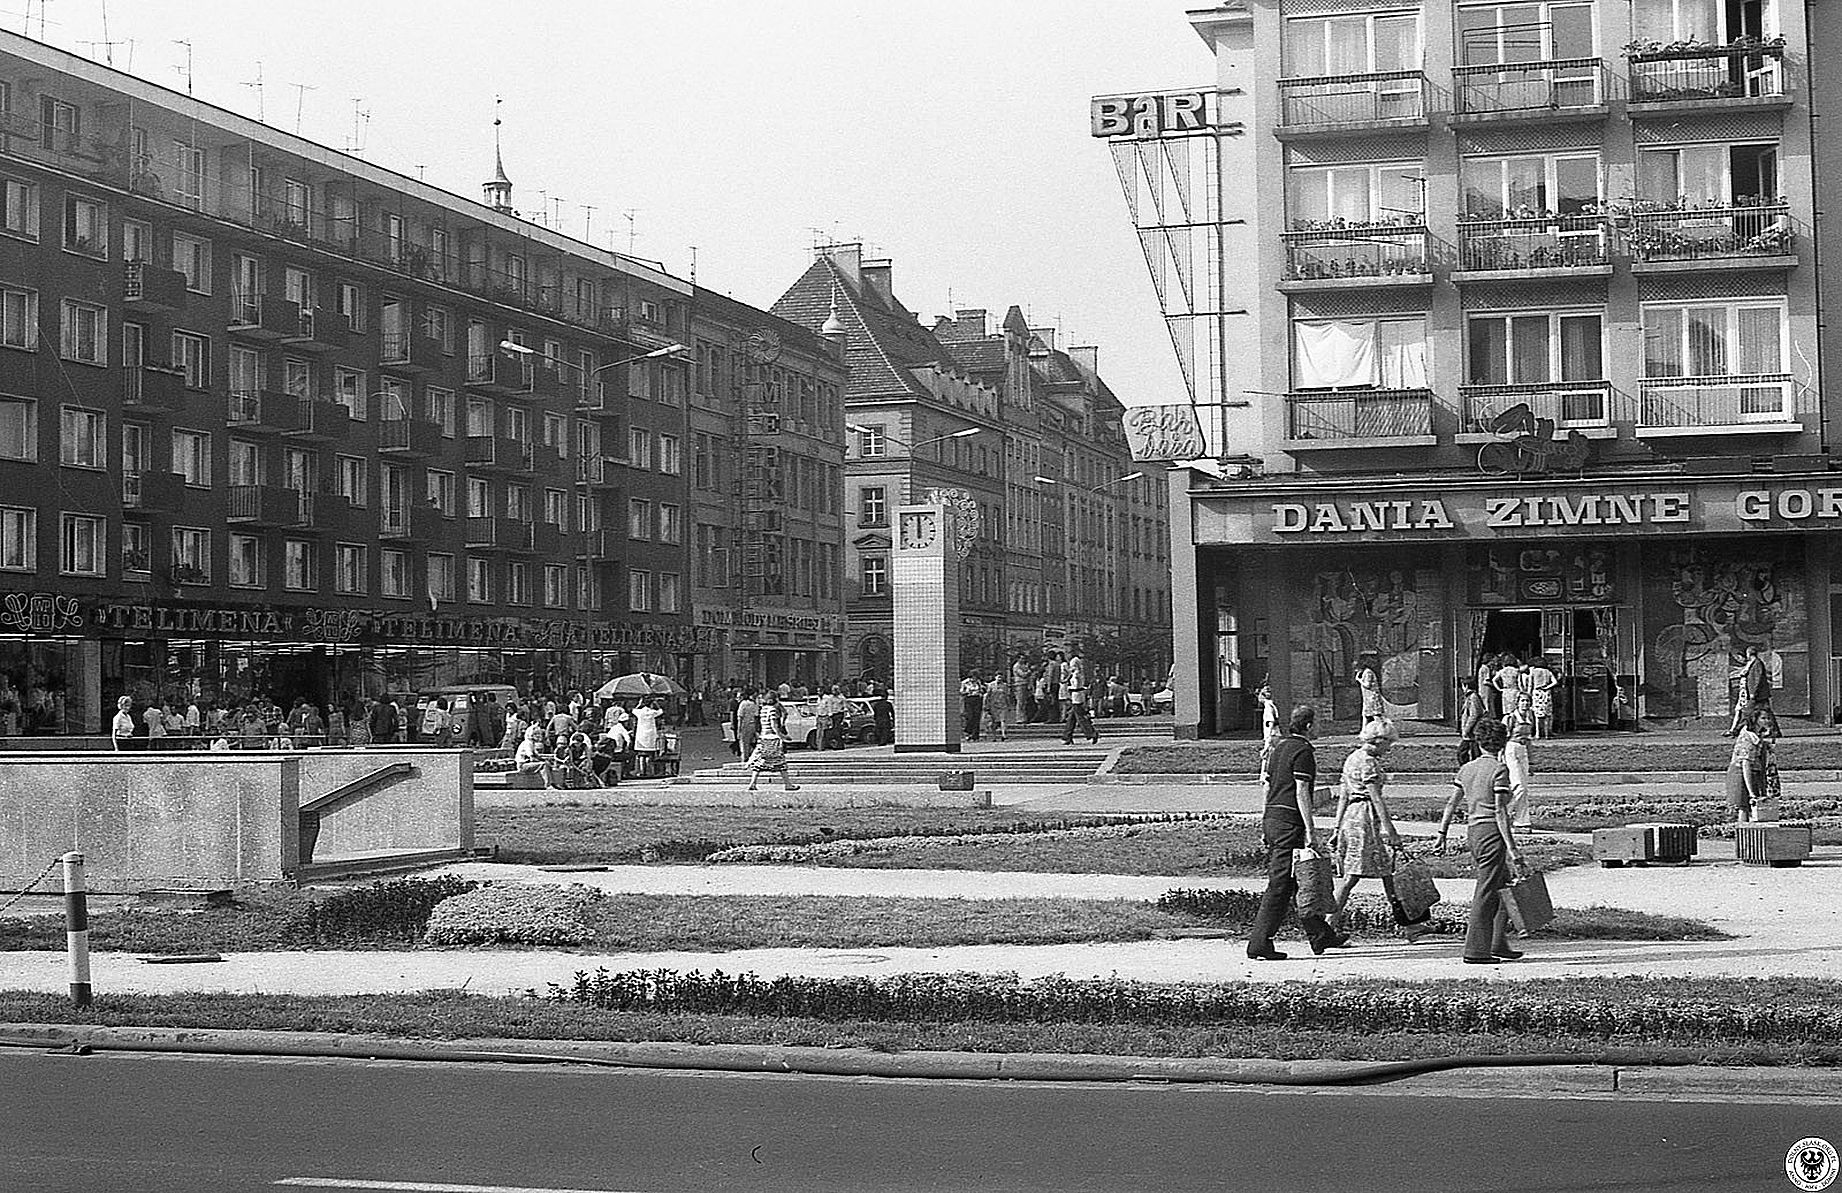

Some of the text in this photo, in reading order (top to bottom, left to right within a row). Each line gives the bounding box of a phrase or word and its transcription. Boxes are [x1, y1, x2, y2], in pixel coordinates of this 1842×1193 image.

[1271, 487, 1842, 533] DANIA ZIMNE GOR
